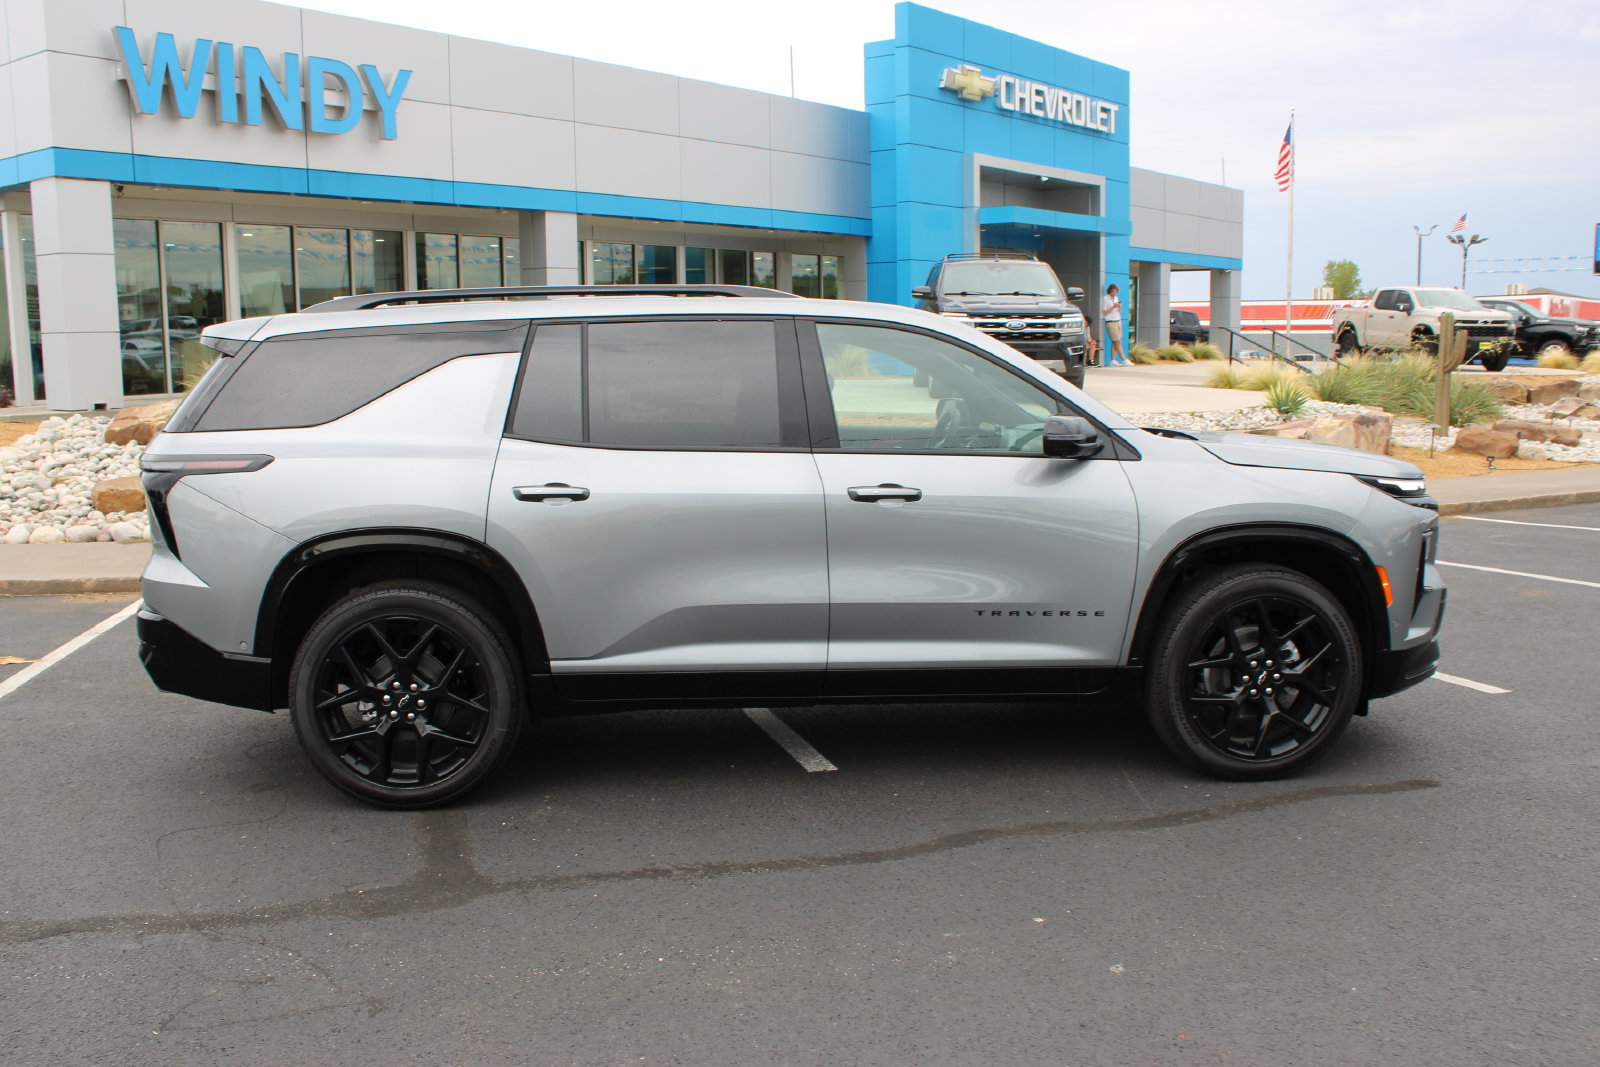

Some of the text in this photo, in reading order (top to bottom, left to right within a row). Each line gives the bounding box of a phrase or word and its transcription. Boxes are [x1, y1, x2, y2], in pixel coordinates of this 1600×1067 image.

[112, 25, 413, 140] WINDY
[997, 74, 1119, 134] CHEVROLET
[975, 609, 1105, 617] TRAVERSE
